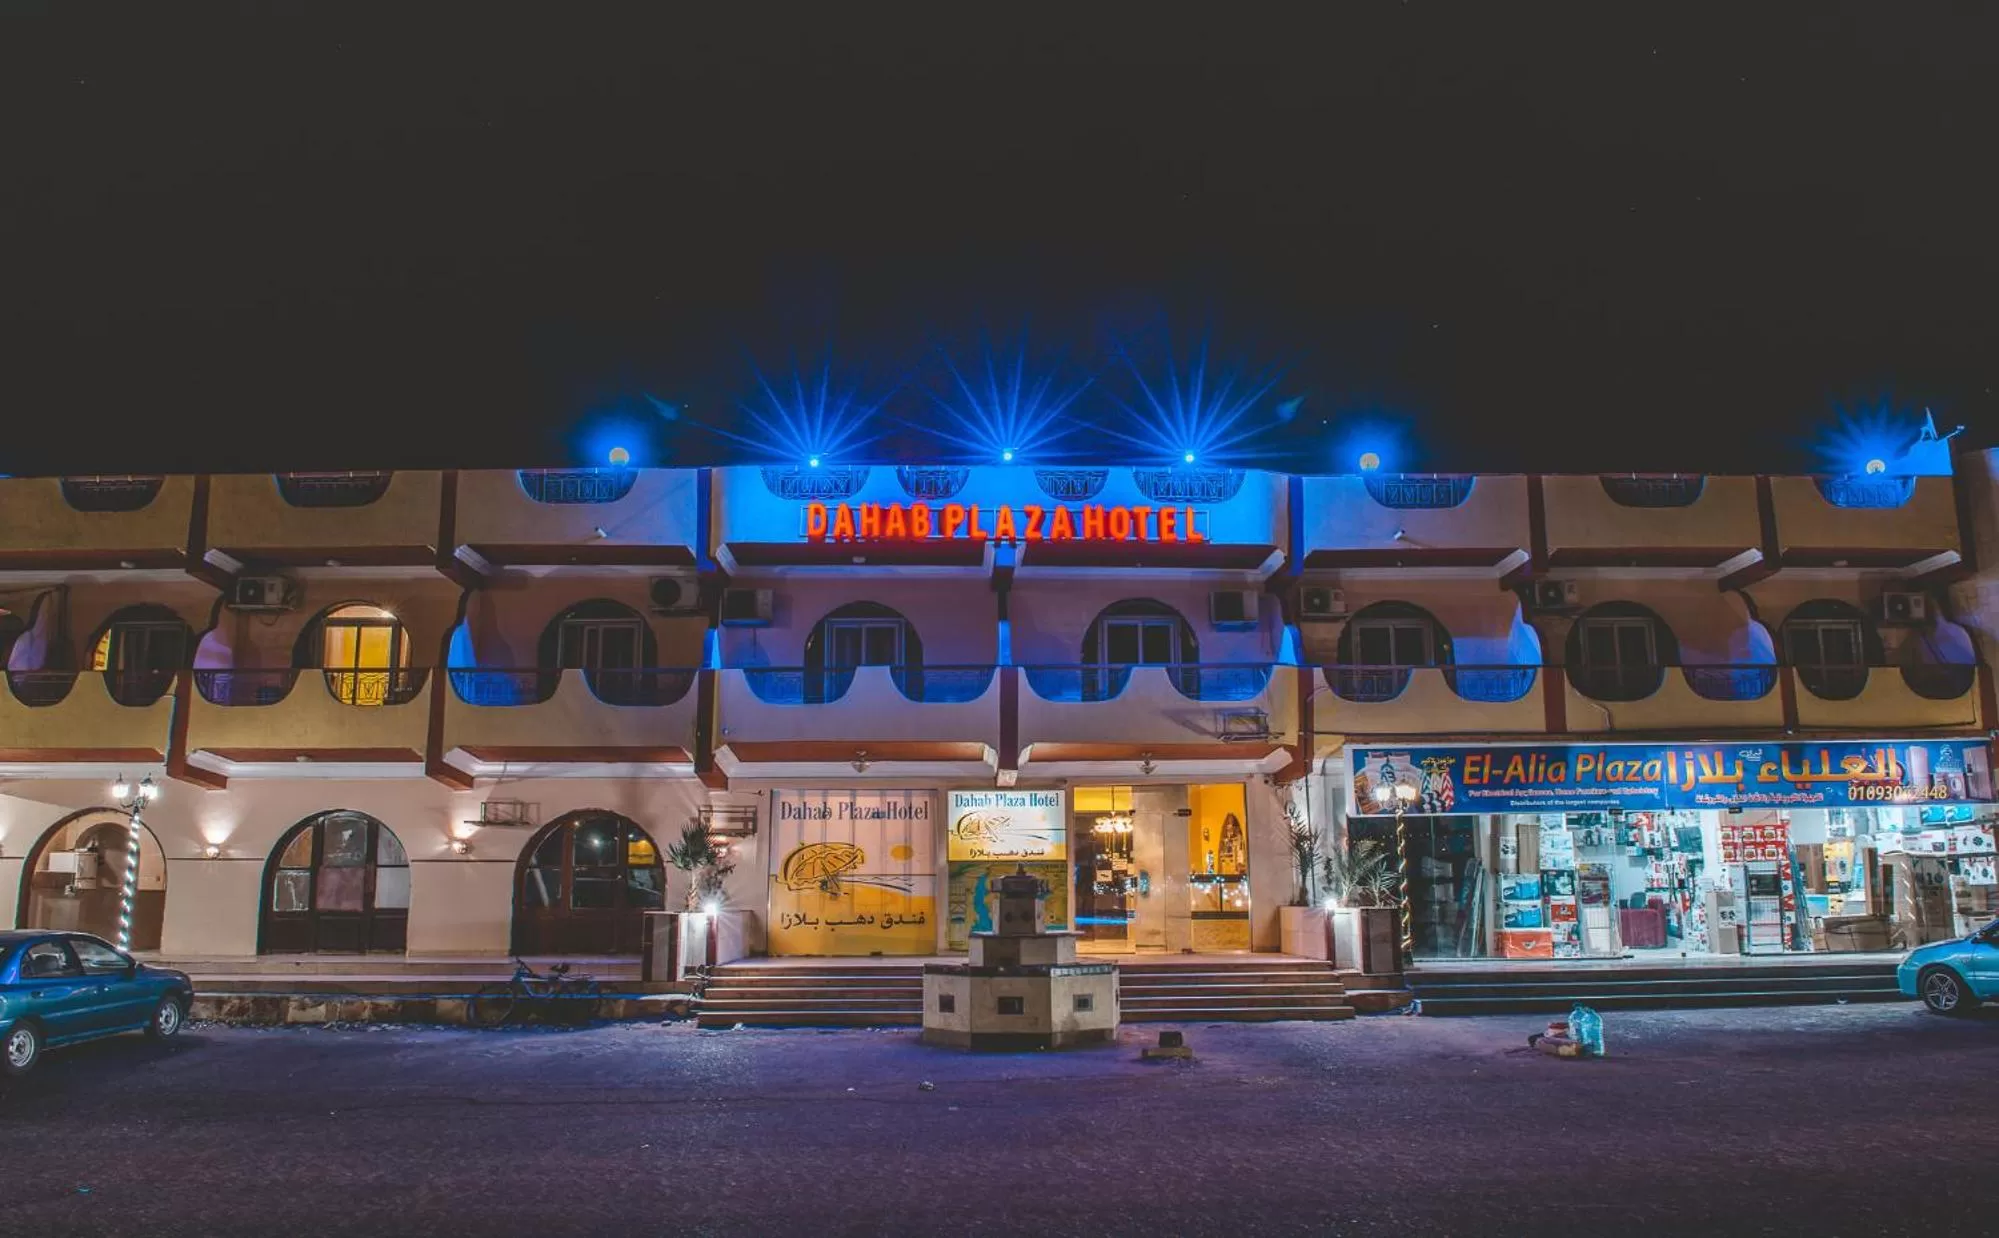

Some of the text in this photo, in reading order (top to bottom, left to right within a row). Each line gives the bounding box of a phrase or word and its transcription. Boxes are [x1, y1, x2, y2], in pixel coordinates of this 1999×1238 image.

[807, 502, 1204, 543] DAHAB PLAZA HOTEL
[1462, 751, 1663, 786] El-Alia Plaza
[1666, 747, 1898, 792] العلياء بلازا
[781, 800, 929, 821] Dahab Plaza Hotel
[955, 792, 1059, 808] Dahab Plaza Hotel
[781, 911, 926, 932] فندق دهب بلازا
